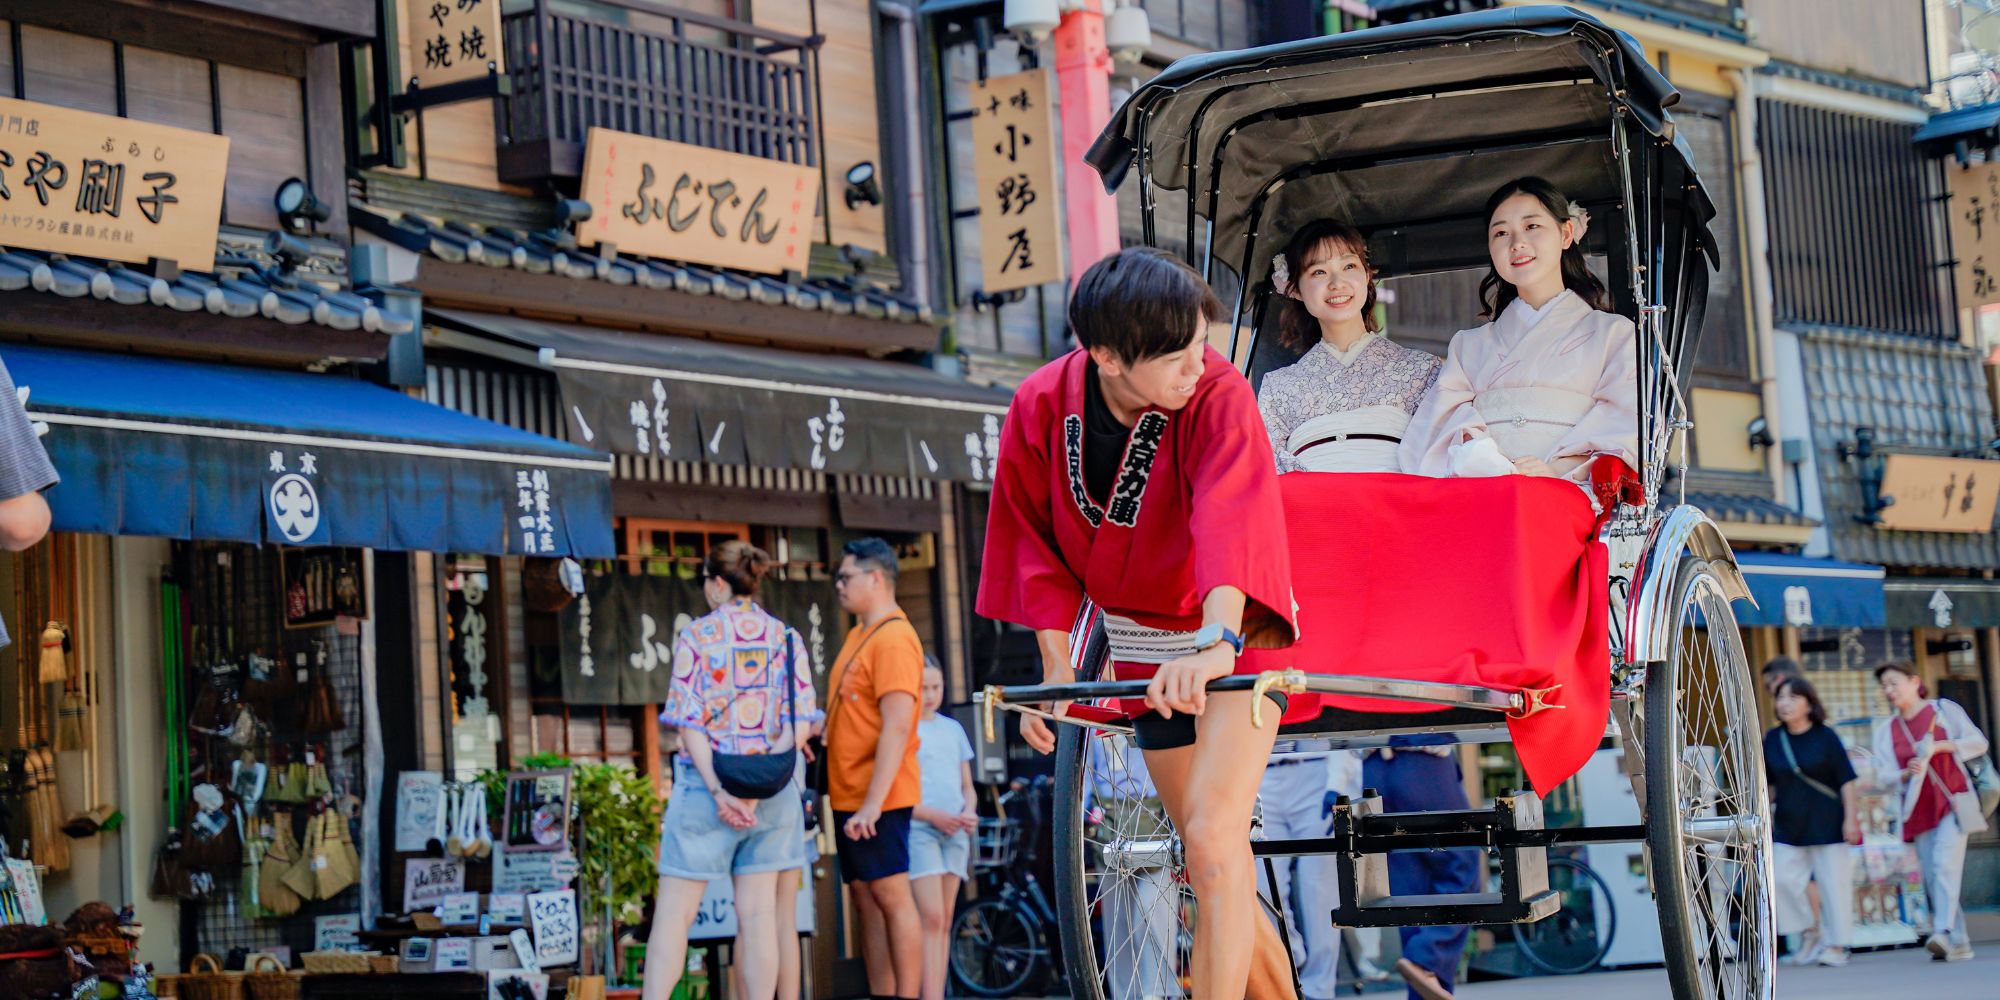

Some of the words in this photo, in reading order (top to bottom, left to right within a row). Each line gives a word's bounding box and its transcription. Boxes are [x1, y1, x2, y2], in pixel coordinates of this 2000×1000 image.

[0, 115, 40, 137] 門店
[622, 162, 780, 244] ふじでん
[994, 125, 1036, 273] 小野屋
[269, 451, 318, 476] 東京
[807, 417, 826, 470] でん
[826, 398, 845, 451] ふじ
[532, 469, 556, 552] 創業大正
[1105, 411, 1169, 528] 東京力車
[517, 471, 537, 554] 三年四月
